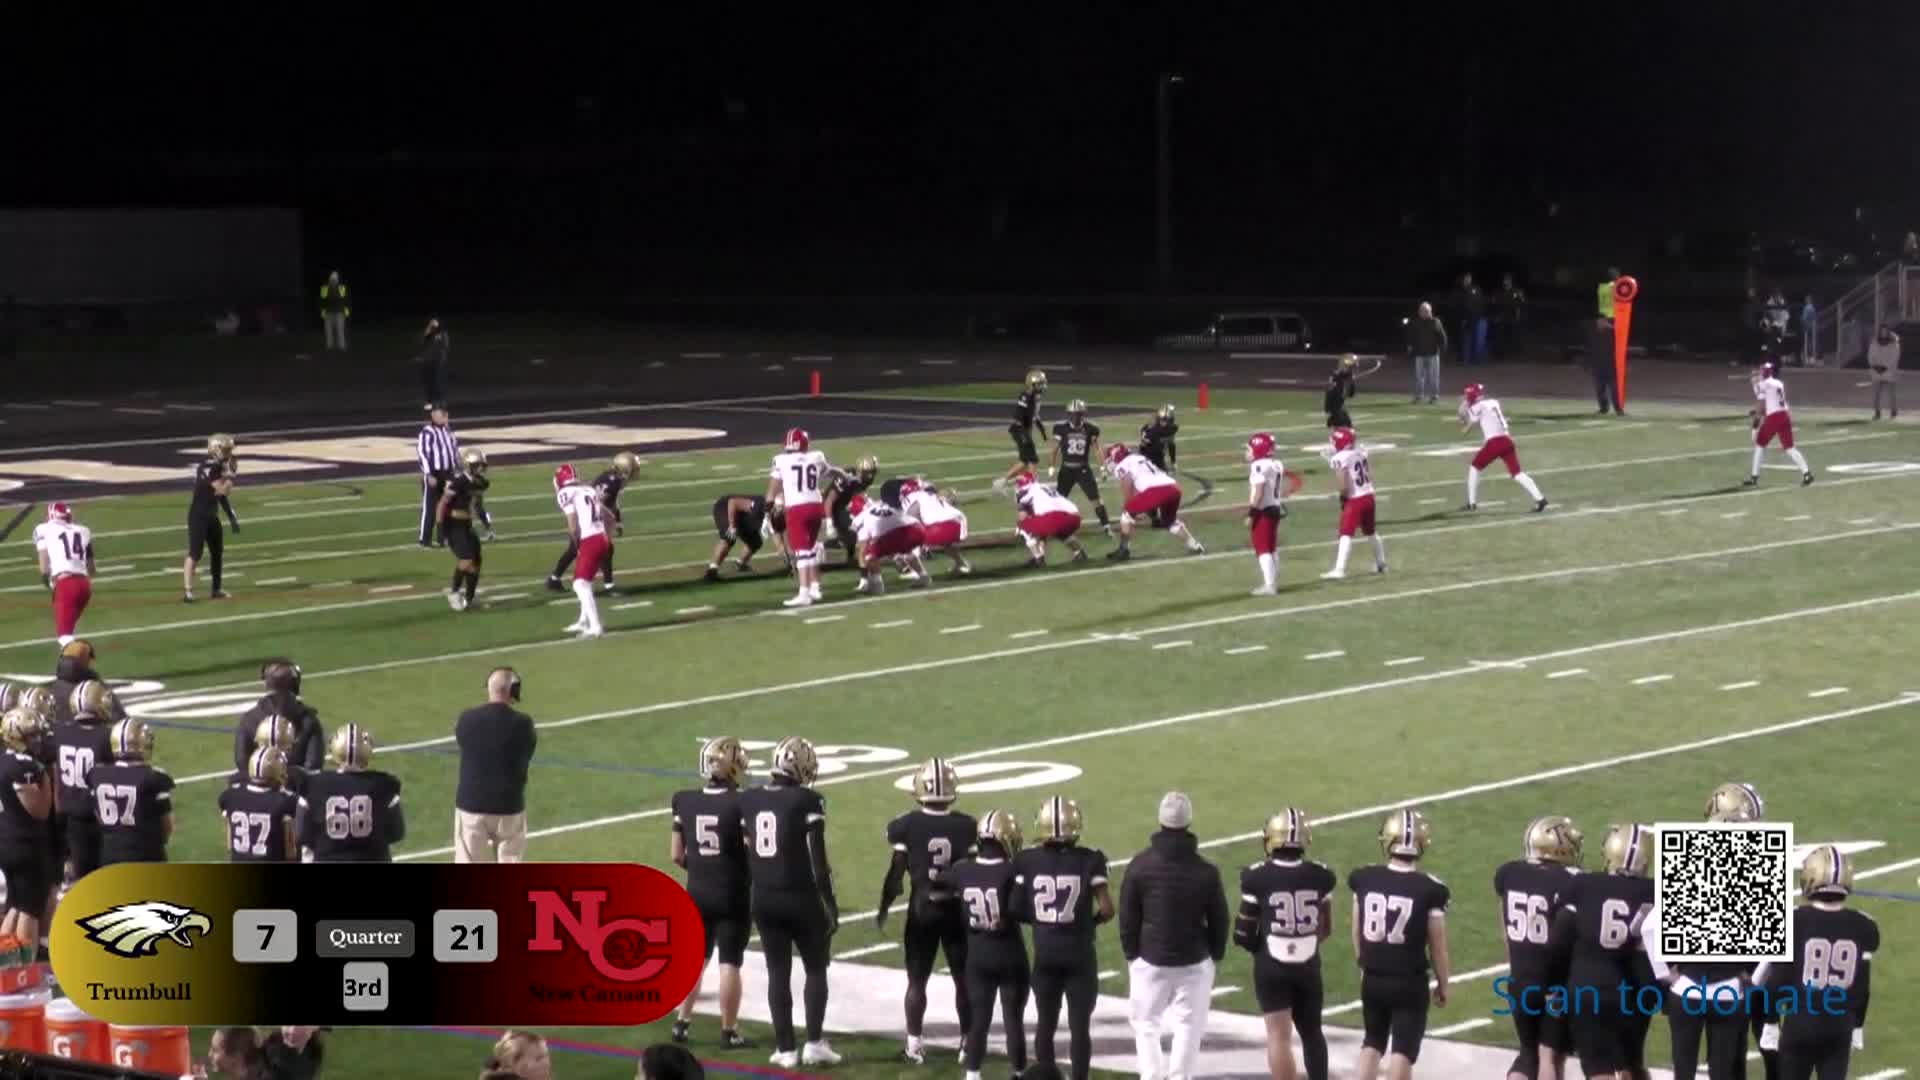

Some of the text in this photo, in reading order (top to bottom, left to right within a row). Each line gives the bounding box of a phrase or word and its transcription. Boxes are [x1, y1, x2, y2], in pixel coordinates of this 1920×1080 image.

[791, 464, 817, 492] 76
[58, 531, 84, 560] 14
[60, 745, 94, 788] 50
[97, 783, 137, 825] 67
[326, 795, 372, 839] 68
[231, 811, 271, 856] 37
[696, 815, 720, 856] 5
[756, 811, 777, 857] 8
[963, 887, 999, 931] 31
[1033, 874, 1081, 923] 27
[1269, 890, 1318, 935] 35
[1364, 892, 1413, 944] 87
[1507, 890, 1548, 944] 56
[1803, 938, 1857, 989] 89
[53, 1036, 72, 1058] G
[115, 1044, 133, 1068] G
